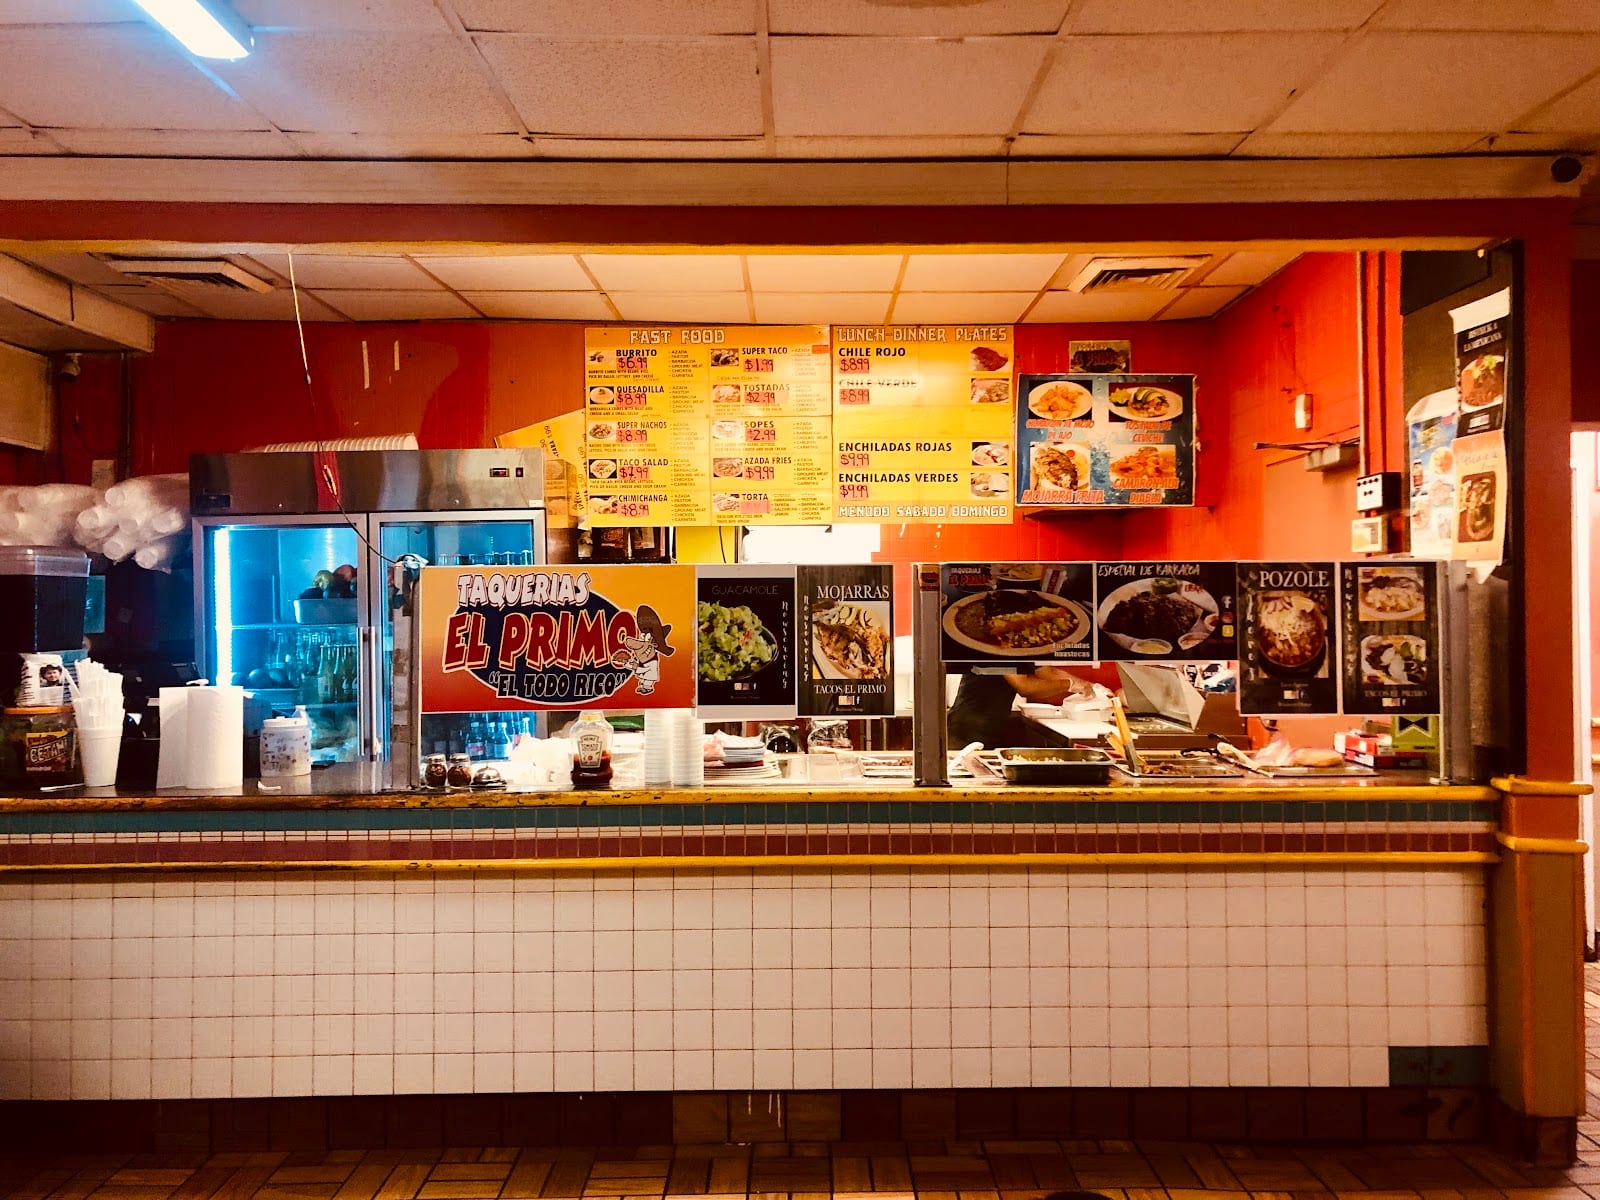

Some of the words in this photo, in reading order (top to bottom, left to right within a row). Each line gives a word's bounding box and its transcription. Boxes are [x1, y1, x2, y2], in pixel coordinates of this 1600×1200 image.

[630, 330, 670, 344] FAST
[681, 329, 724, 344] FOOD
[955, 328, 1007, 341] PLATES
[839, 348, 870, 357] CHILE
[876, 348, 906, 357] ROJO
[618, 357, 648, 369] $6.99
[744, 358, 773, 372] $1.99
[840, 358, 870, 372] $8.99
[617, 393, 647, 405] $8.99
[746, 392, 775, 403] $2.99
[617, 430, 647, 442] $8.99
[839, 443, 911, 452] ENCHILADAS
[916, 443, 952, 452] ROJAS
[840, 453, 870, 467] $9.99
[746, 466, 774, 479] $9.99
[839, 474, 910, 483] ENCHILADAS
[915, 474, 959, 483] VERDES
[840, 485, 868, 498] $9.99
[1022, 490, 1074, 503] MOJARRA
[1075, 490, 1104, 502] FRITA
[621, 504, 649, 517] $8.99
[838, 506, 890, 517] MENUDO
[897, 506, 946, 517] SABADO
[951, 505, 1008, 517] DOMINGO
[1098, 565, 1136, 577] ESPECIAL
[1140, 565, 1155, 576] DE
[1260, 570, 1329, 588] POZOLE
[458, 573, 591, 611] TAQUERIAS
[712, 585, 780, 596] GUACAMOLE
[816, 585, 890, 601] MOJARRAS
[443, 612, 490, 673] EL
[499, 609, 638, 672] PRIMO
[524, 673, 570, 696] TODO
[814, 685, 842, 694] TACOS
[844, 685, 856, 694] EL
[857, 684, 886, 694] PRIMO
